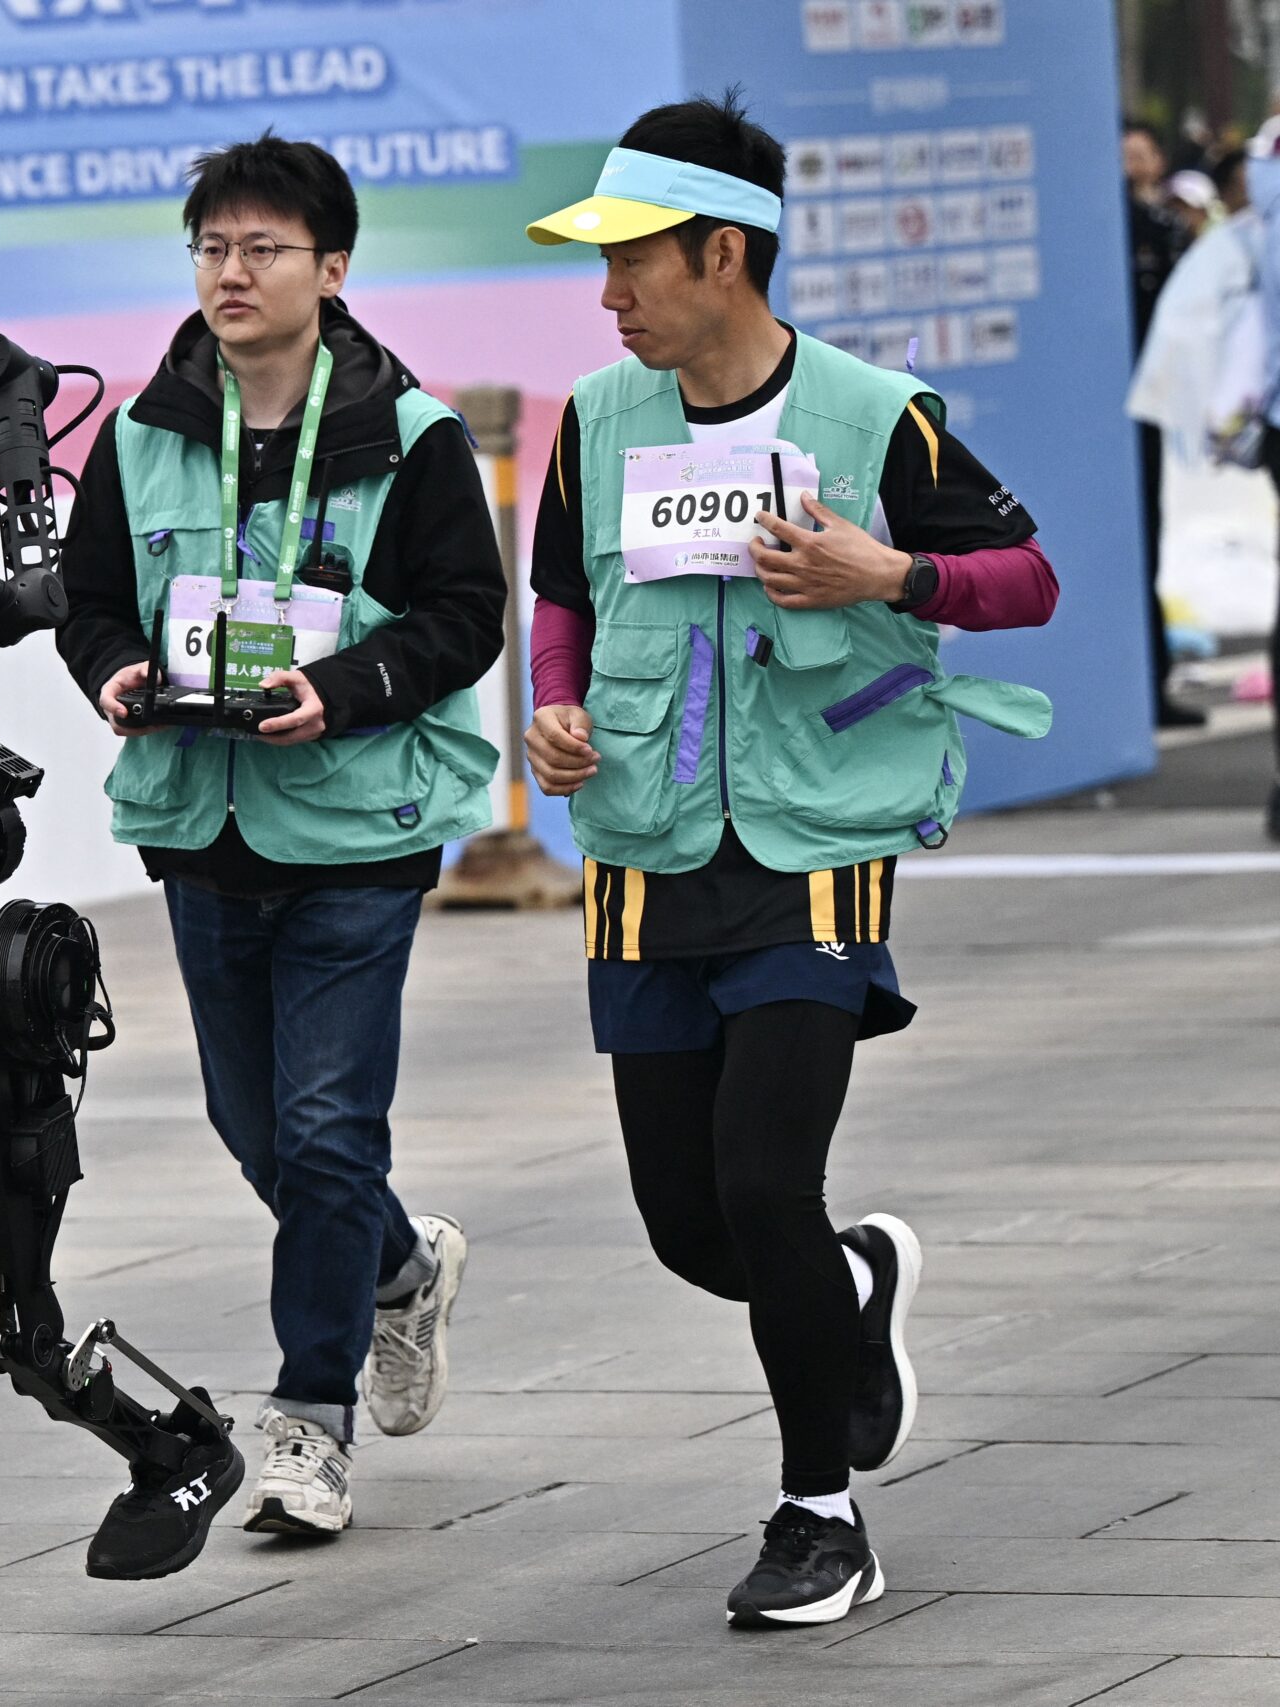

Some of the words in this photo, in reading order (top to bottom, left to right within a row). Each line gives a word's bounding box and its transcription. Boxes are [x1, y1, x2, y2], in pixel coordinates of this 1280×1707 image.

[31, 57, 170, 107] TAKES
[175, 52, 262, 99] THE
[267, 46, 387, 95] LEAD
[332, 126, 507, 178] FUTURE
[652, 490, 772, 528] 60901
[692, 528, 721, 538] 天工队
[170, 1471, 212, 1511] 天工
